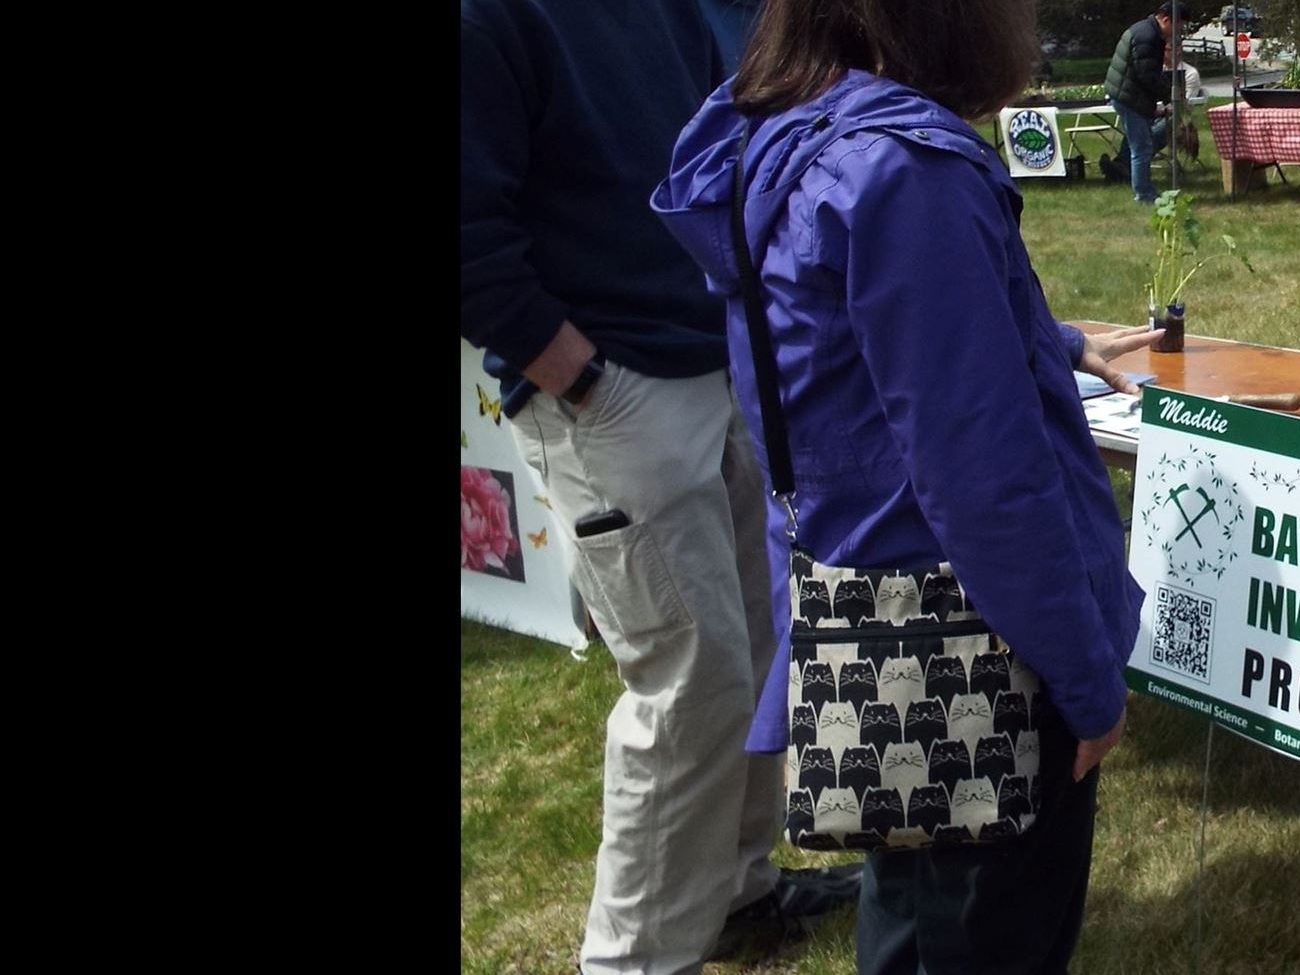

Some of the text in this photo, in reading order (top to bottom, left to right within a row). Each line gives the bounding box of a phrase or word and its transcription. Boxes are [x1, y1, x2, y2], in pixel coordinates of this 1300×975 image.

[1010, 111, 1050, 138] REAL
[1158, 396, 1229, 434] Maddie
[1147, 681, 1212, 714] Environmental
[1213, 705, 1248, 728] Science
